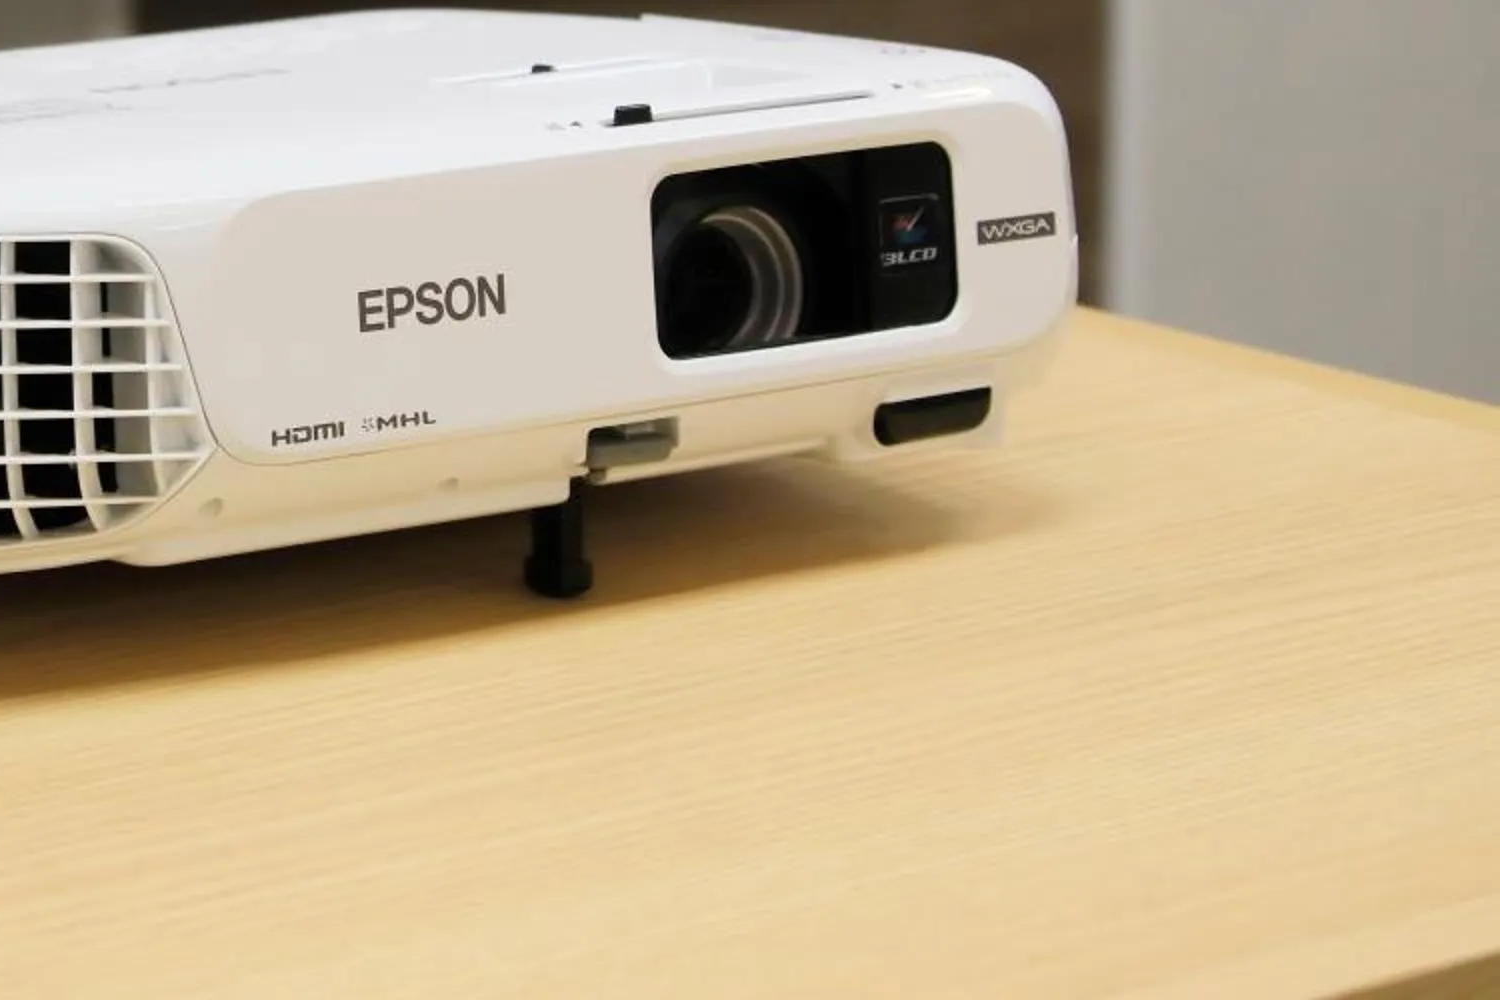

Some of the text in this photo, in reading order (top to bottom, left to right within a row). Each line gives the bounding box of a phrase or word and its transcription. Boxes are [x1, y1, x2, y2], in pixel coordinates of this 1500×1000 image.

[980, 216, 1052, 240] WXGA
[882, 247, 937, 267] 3LCD
[357, 273, 506, 332] EPSON
[271, 410, 437, 447] HDMI MHL
